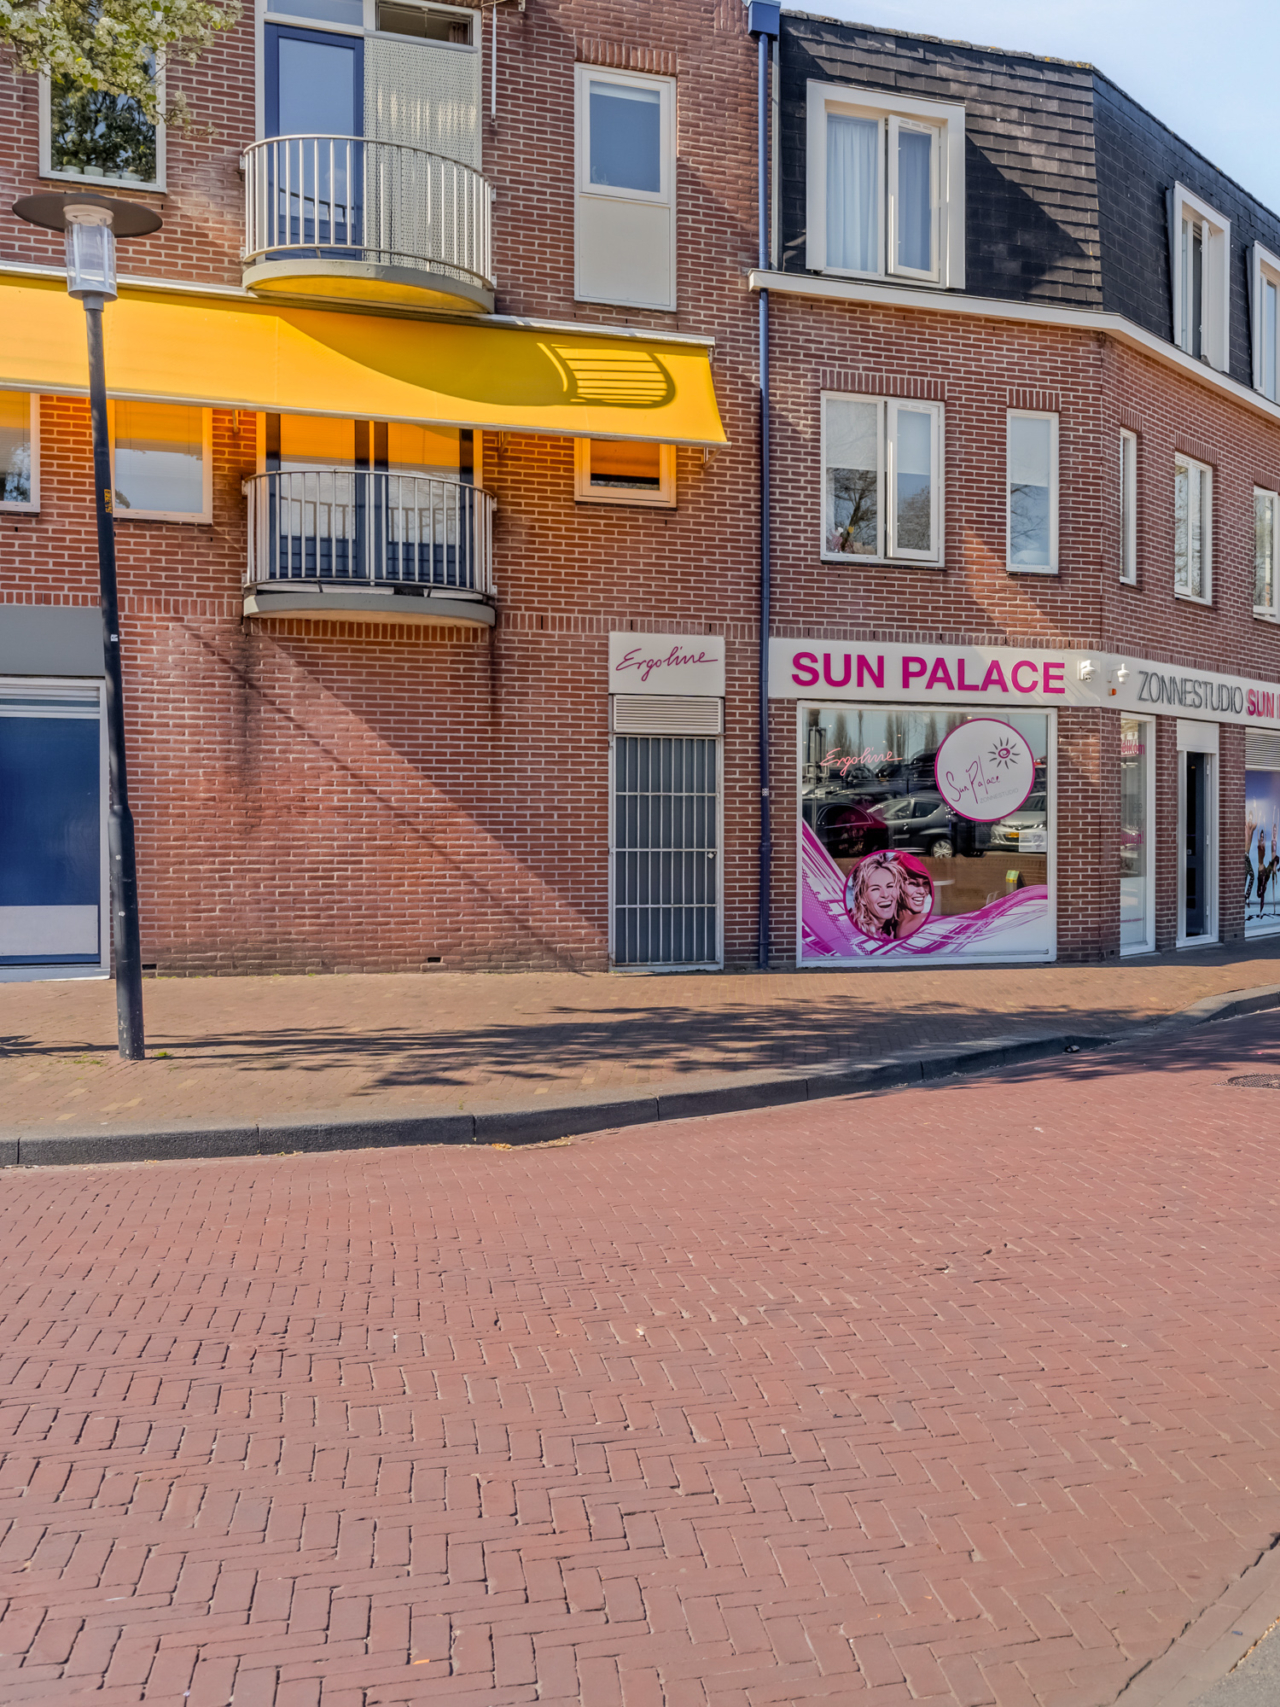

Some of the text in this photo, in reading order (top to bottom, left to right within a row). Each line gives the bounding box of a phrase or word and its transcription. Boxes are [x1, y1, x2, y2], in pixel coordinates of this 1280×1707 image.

[616, 646, 718, 682] Ergoline
[791, 652, 1066, 694] SUN PALACE
[1137, 671, 1244, 714] ZONNESTUDIO
[1246, 688, 1275, 719] SUN
[819, 747, 903, 776] Ergoline
[945, 755, 1001, 805] Sun Palace
[979, 787, 1019, 804] ZONNESTUDIO
